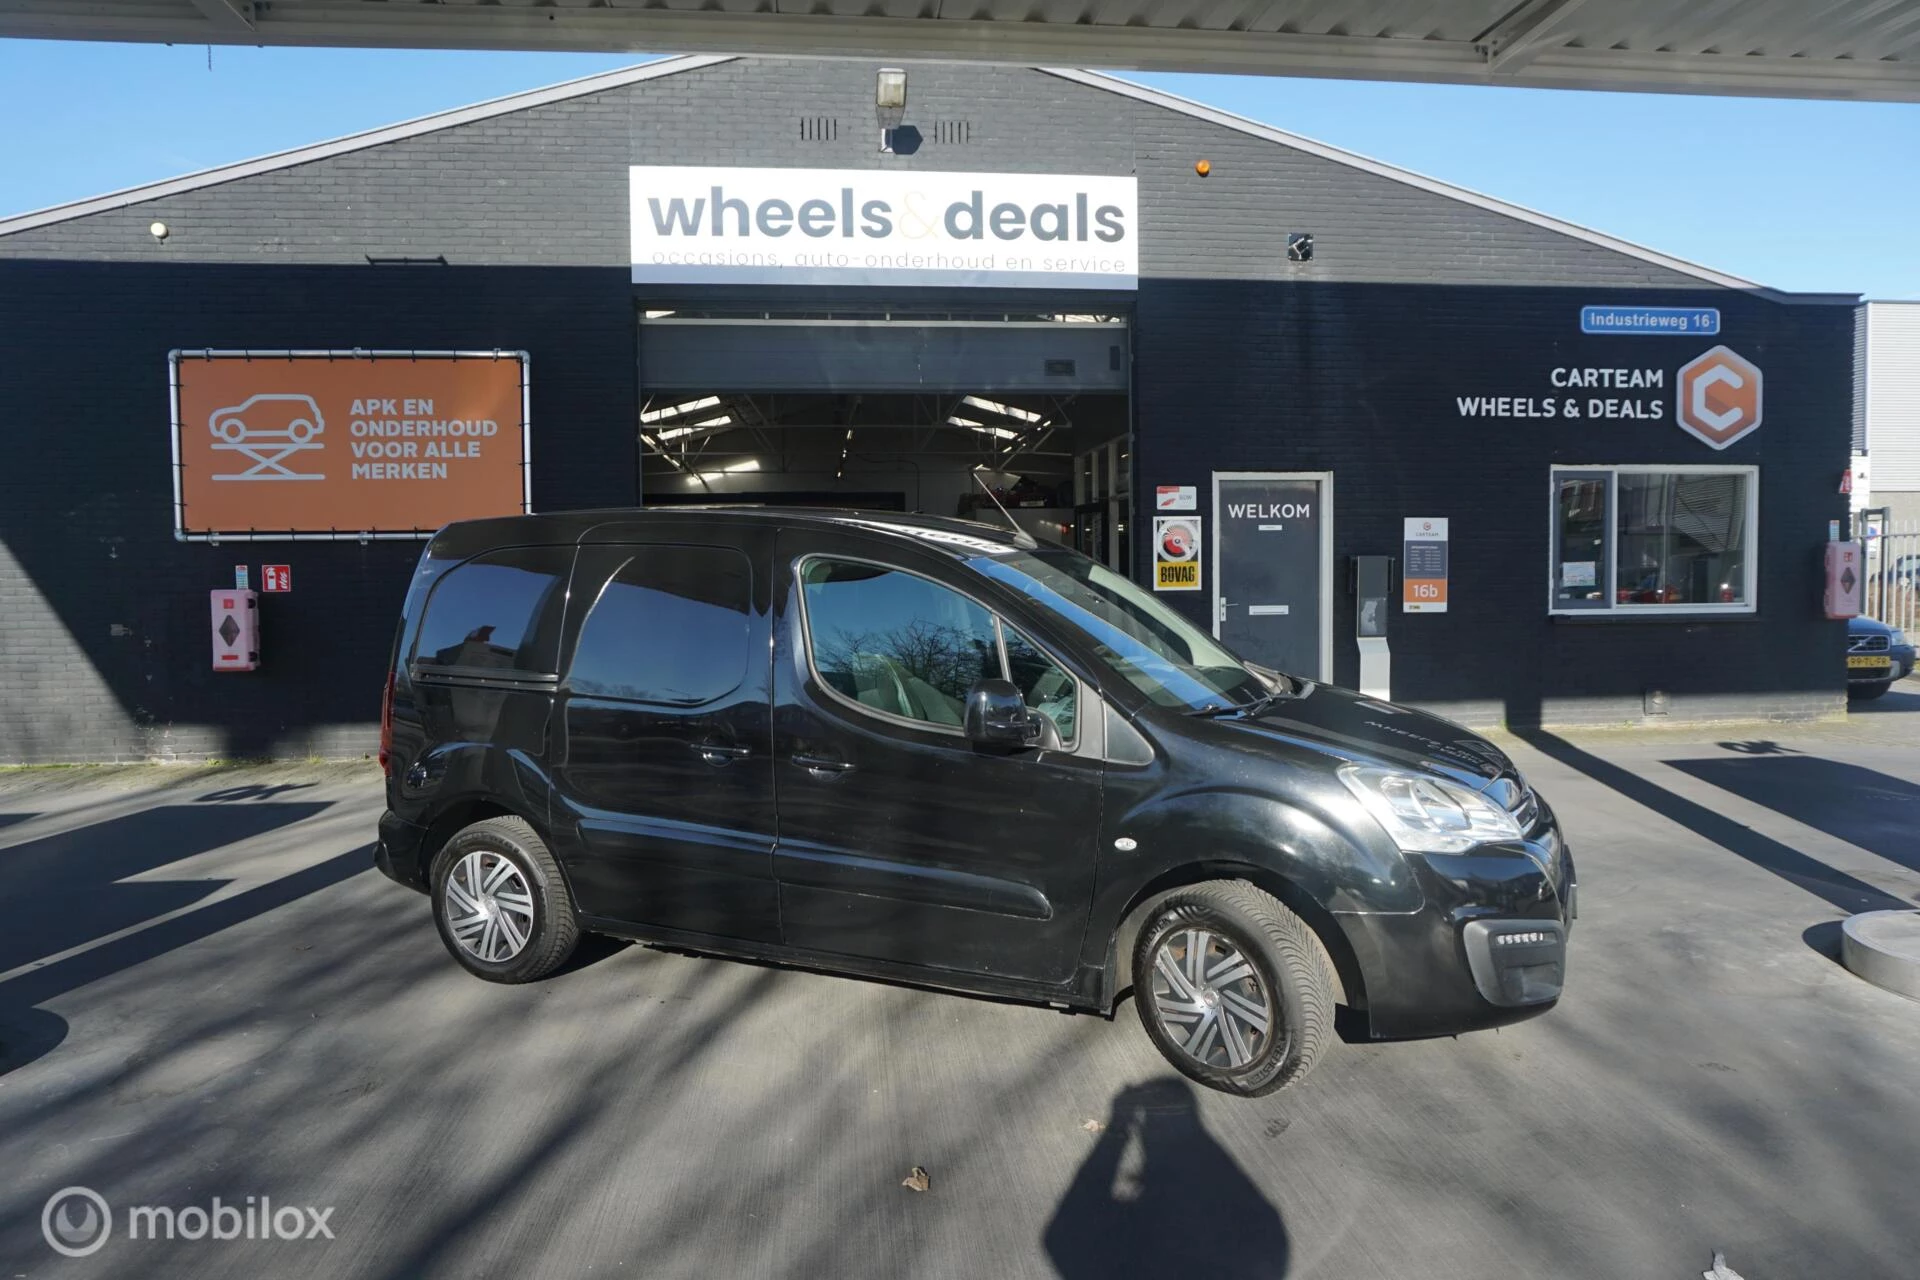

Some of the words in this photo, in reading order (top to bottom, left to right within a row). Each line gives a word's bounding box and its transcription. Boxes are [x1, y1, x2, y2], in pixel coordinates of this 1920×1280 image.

[1005, 256, 1032, 270] en
[1042, 256, 1126, 273] service
[1590, 312, 1688, 330] Industrieweg
[1693, 314, 1710, 328] 16
[1551, 367, 1664, 389] CARTEAM
[350, 399, 398, 416] APK
[403, 399, 434, 416] EN
[1456, 396, 1556, 418] WHEELS
[1563, 398, 1581, 418] &
[1588, 399, 1664, 419] DEALS
[350, 420, 498, 437] ONDERHOUD
[351, 441, 418, 458] VOOR
[424, 441, 481, 458] ALLE
[352, 463, 448, 480] MERKEN
[1228, 503, 1310, 518] WELKOM
[1160, 566, 1195, 583] BOVAG
[1412, 584, 1438, 598] 16b
